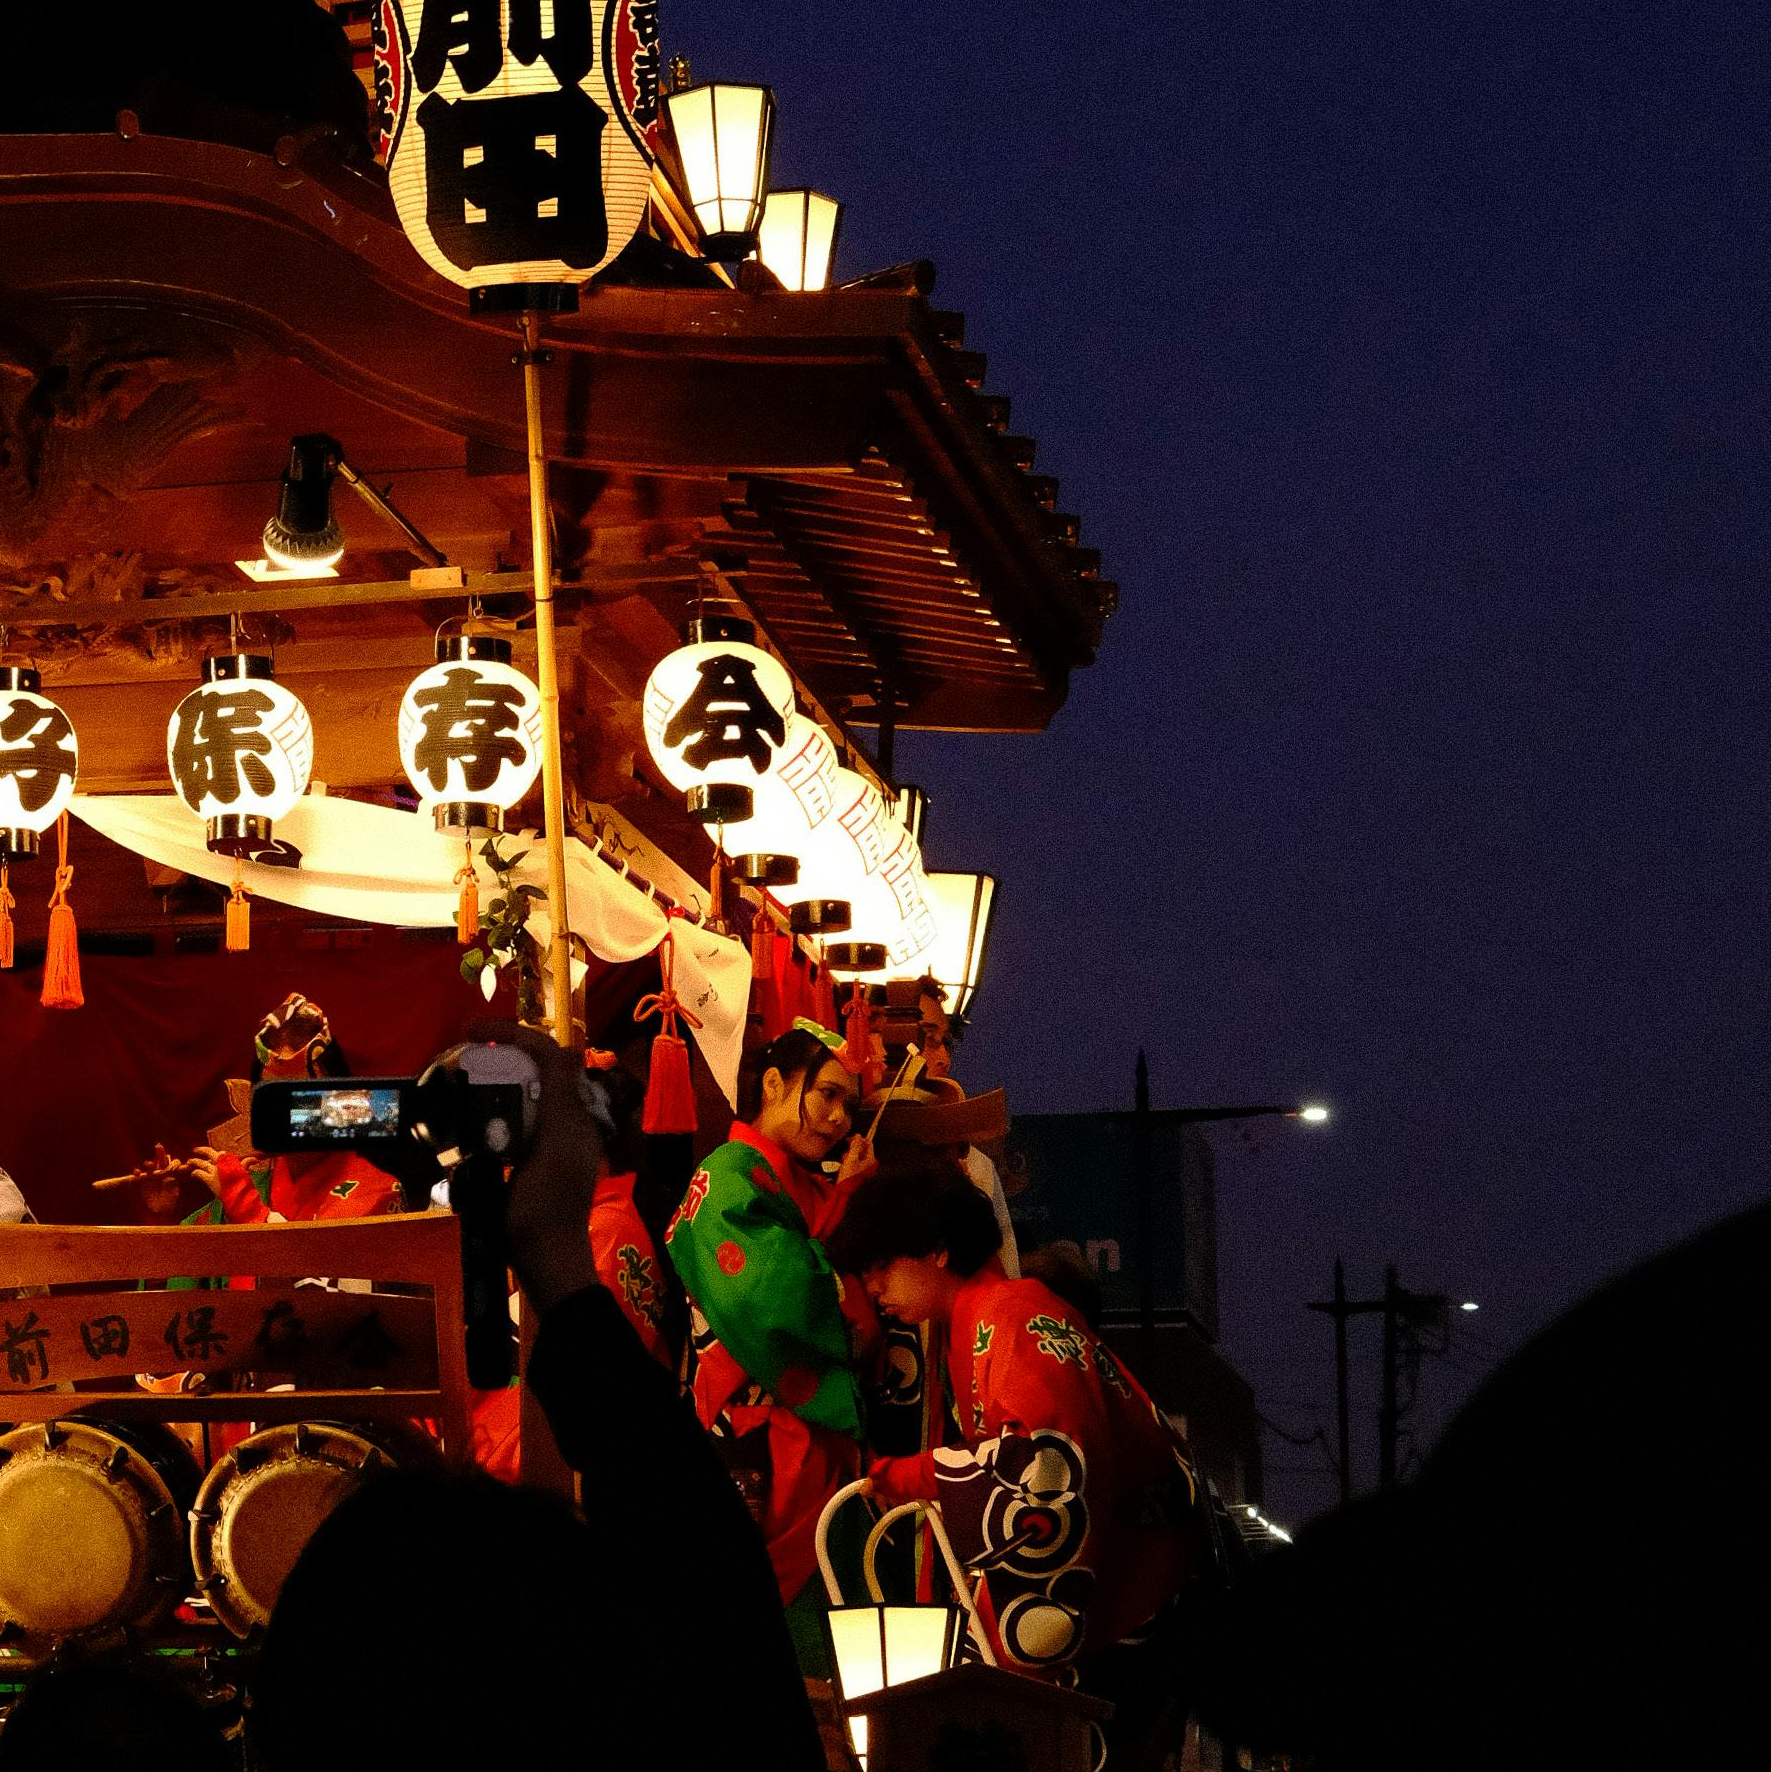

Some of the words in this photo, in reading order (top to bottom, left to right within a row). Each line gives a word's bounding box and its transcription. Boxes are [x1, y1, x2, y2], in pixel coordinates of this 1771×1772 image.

[172, 689, 276, 810] 保
[413, 667, 527, 793] 存
[663, 653, 787, 775] 会
